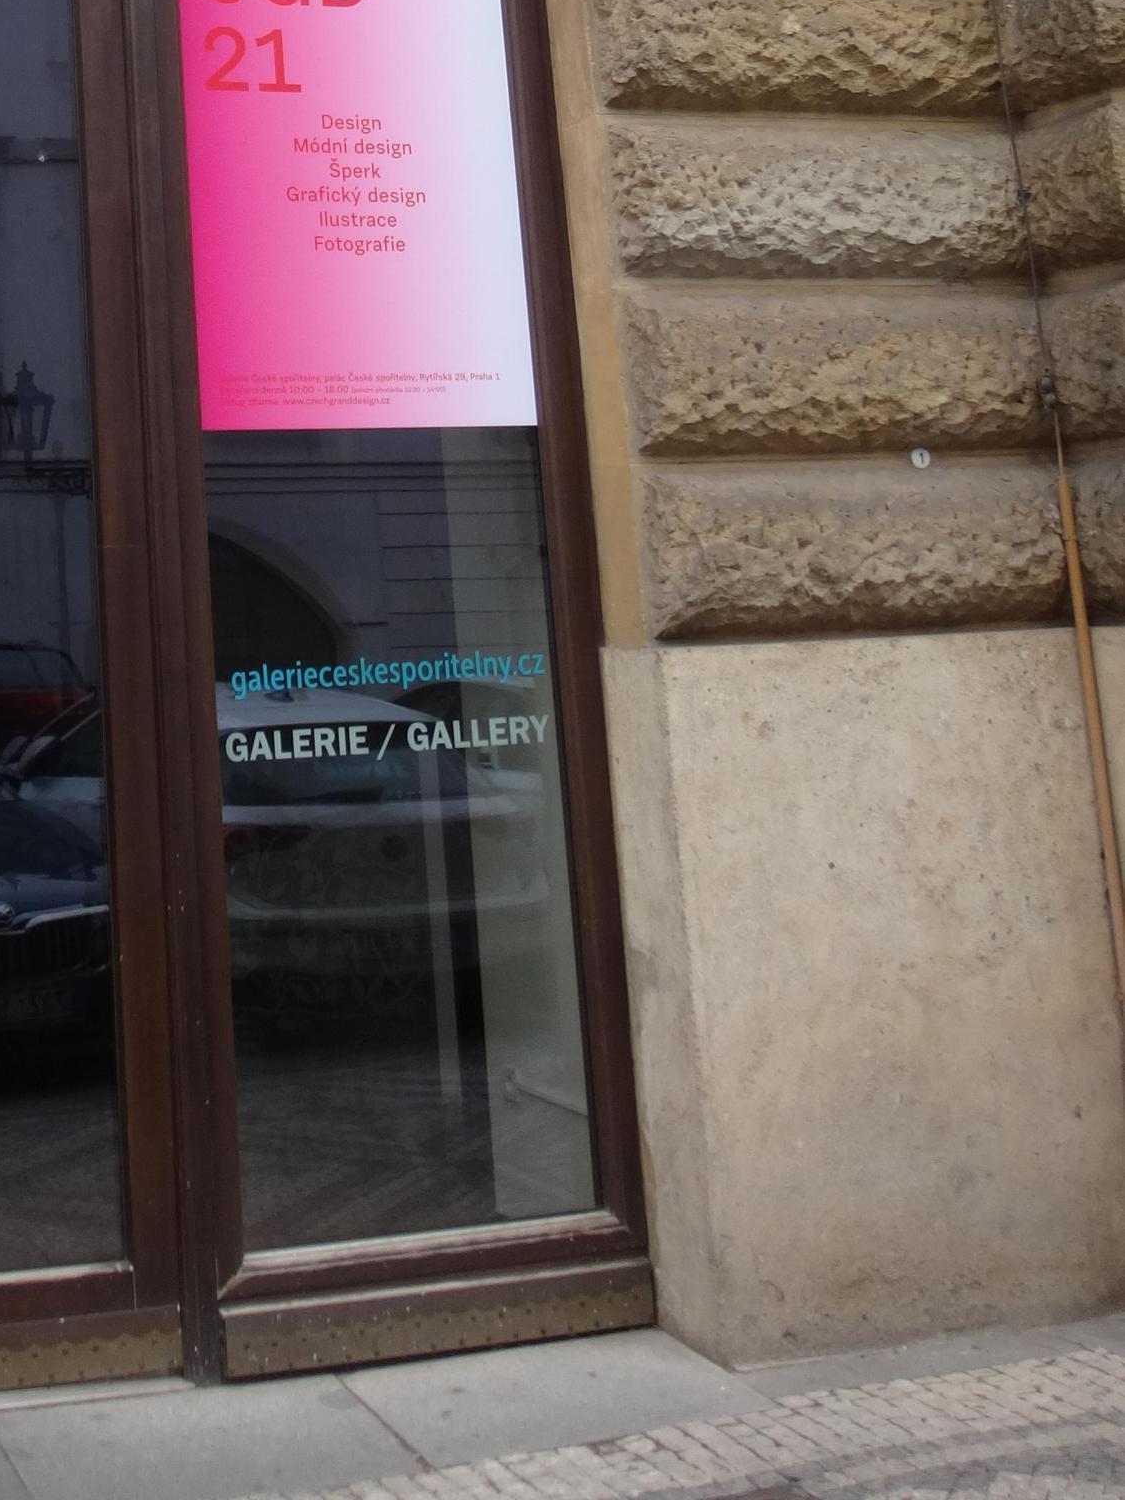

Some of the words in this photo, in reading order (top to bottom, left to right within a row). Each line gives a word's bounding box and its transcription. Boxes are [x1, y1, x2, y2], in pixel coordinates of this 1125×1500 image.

[203, 26, 302, 93] 21
[321, 114, 382, 134] Design
[293, 137, 348, 153] Módní
[354, 139, 412, 159] design
[329, 158, 381, 182] Šperk
[286, 185, 362, 206] Grafický
[368, 187, 426, 208] design
[319, 211, 397, 227] Ilustrace
[314, 235, 406, 256] Fotografie
[455, 373, 468, 382] 29,
[470, 372, 493, 381] Praha
[495, 372, 501, 380] 1
[289, 385, 315, 394] 10:00
[325, 385, 349, 394] 18:00
[231, 650, 547, 700] galerieceskesporitelny.cz
[225, 725, 369, 762] GALERIE
[376, 723, 396, 760] /
[406, 714, 549, 751] GALLERY
